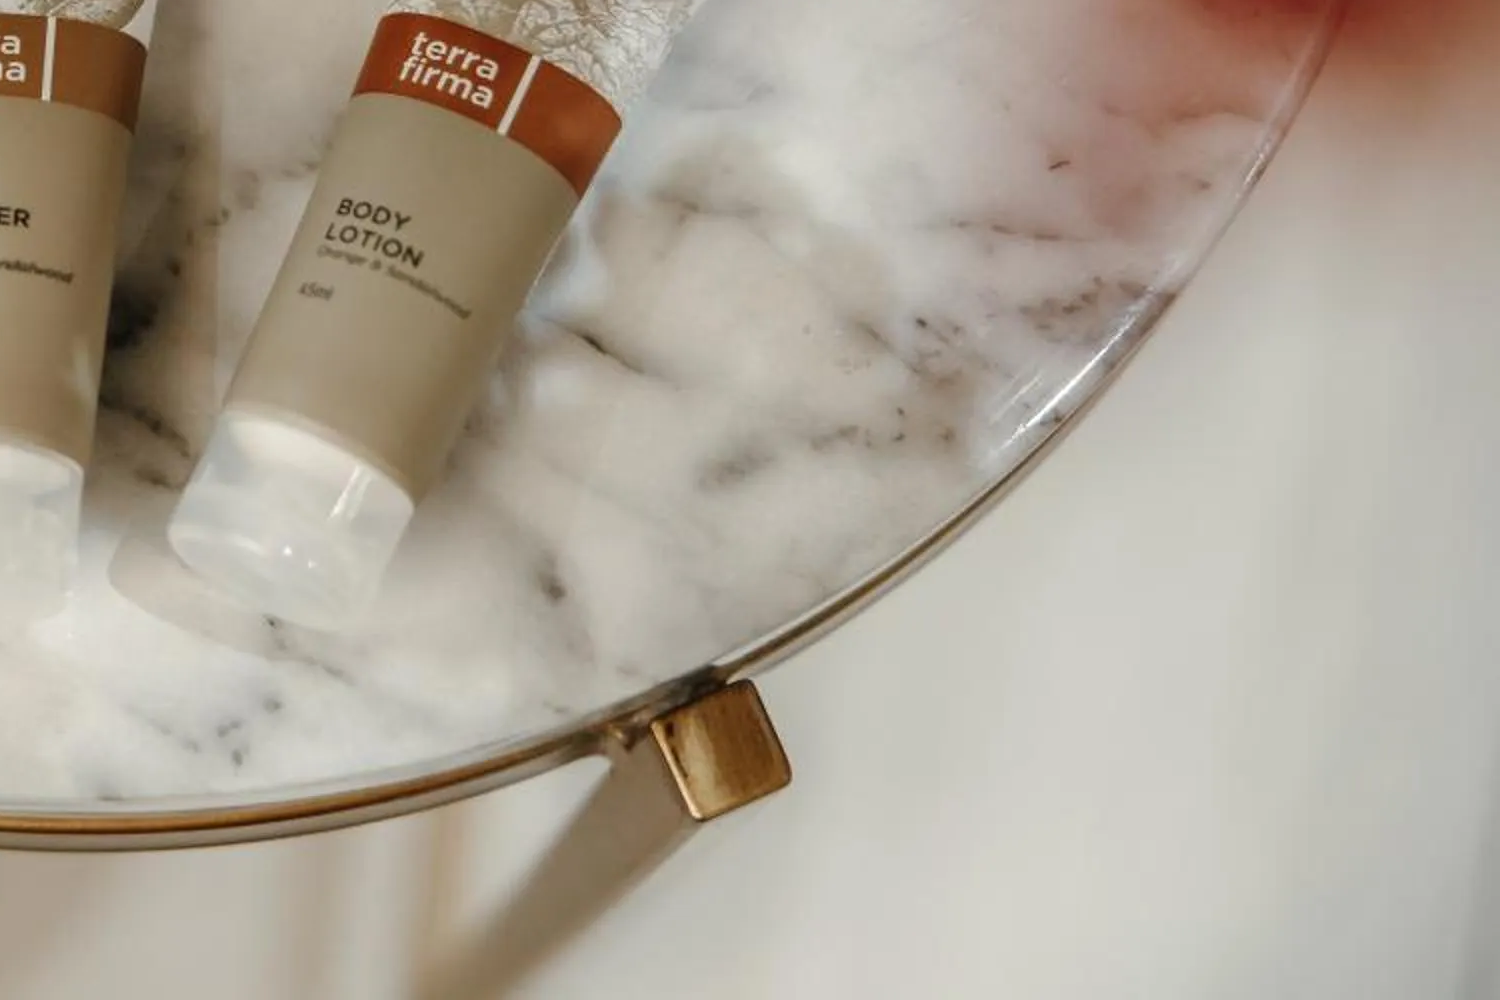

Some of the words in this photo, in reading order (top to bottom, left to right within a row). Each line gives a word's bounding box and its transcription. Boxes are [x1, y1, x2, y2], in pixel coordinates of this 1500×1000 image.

[411, 31, 499, 81] terra
[399, 56, 495, 109] firma
[335, 198, 412, 231] BODY
[324, 223, 425, 269] LOTION
